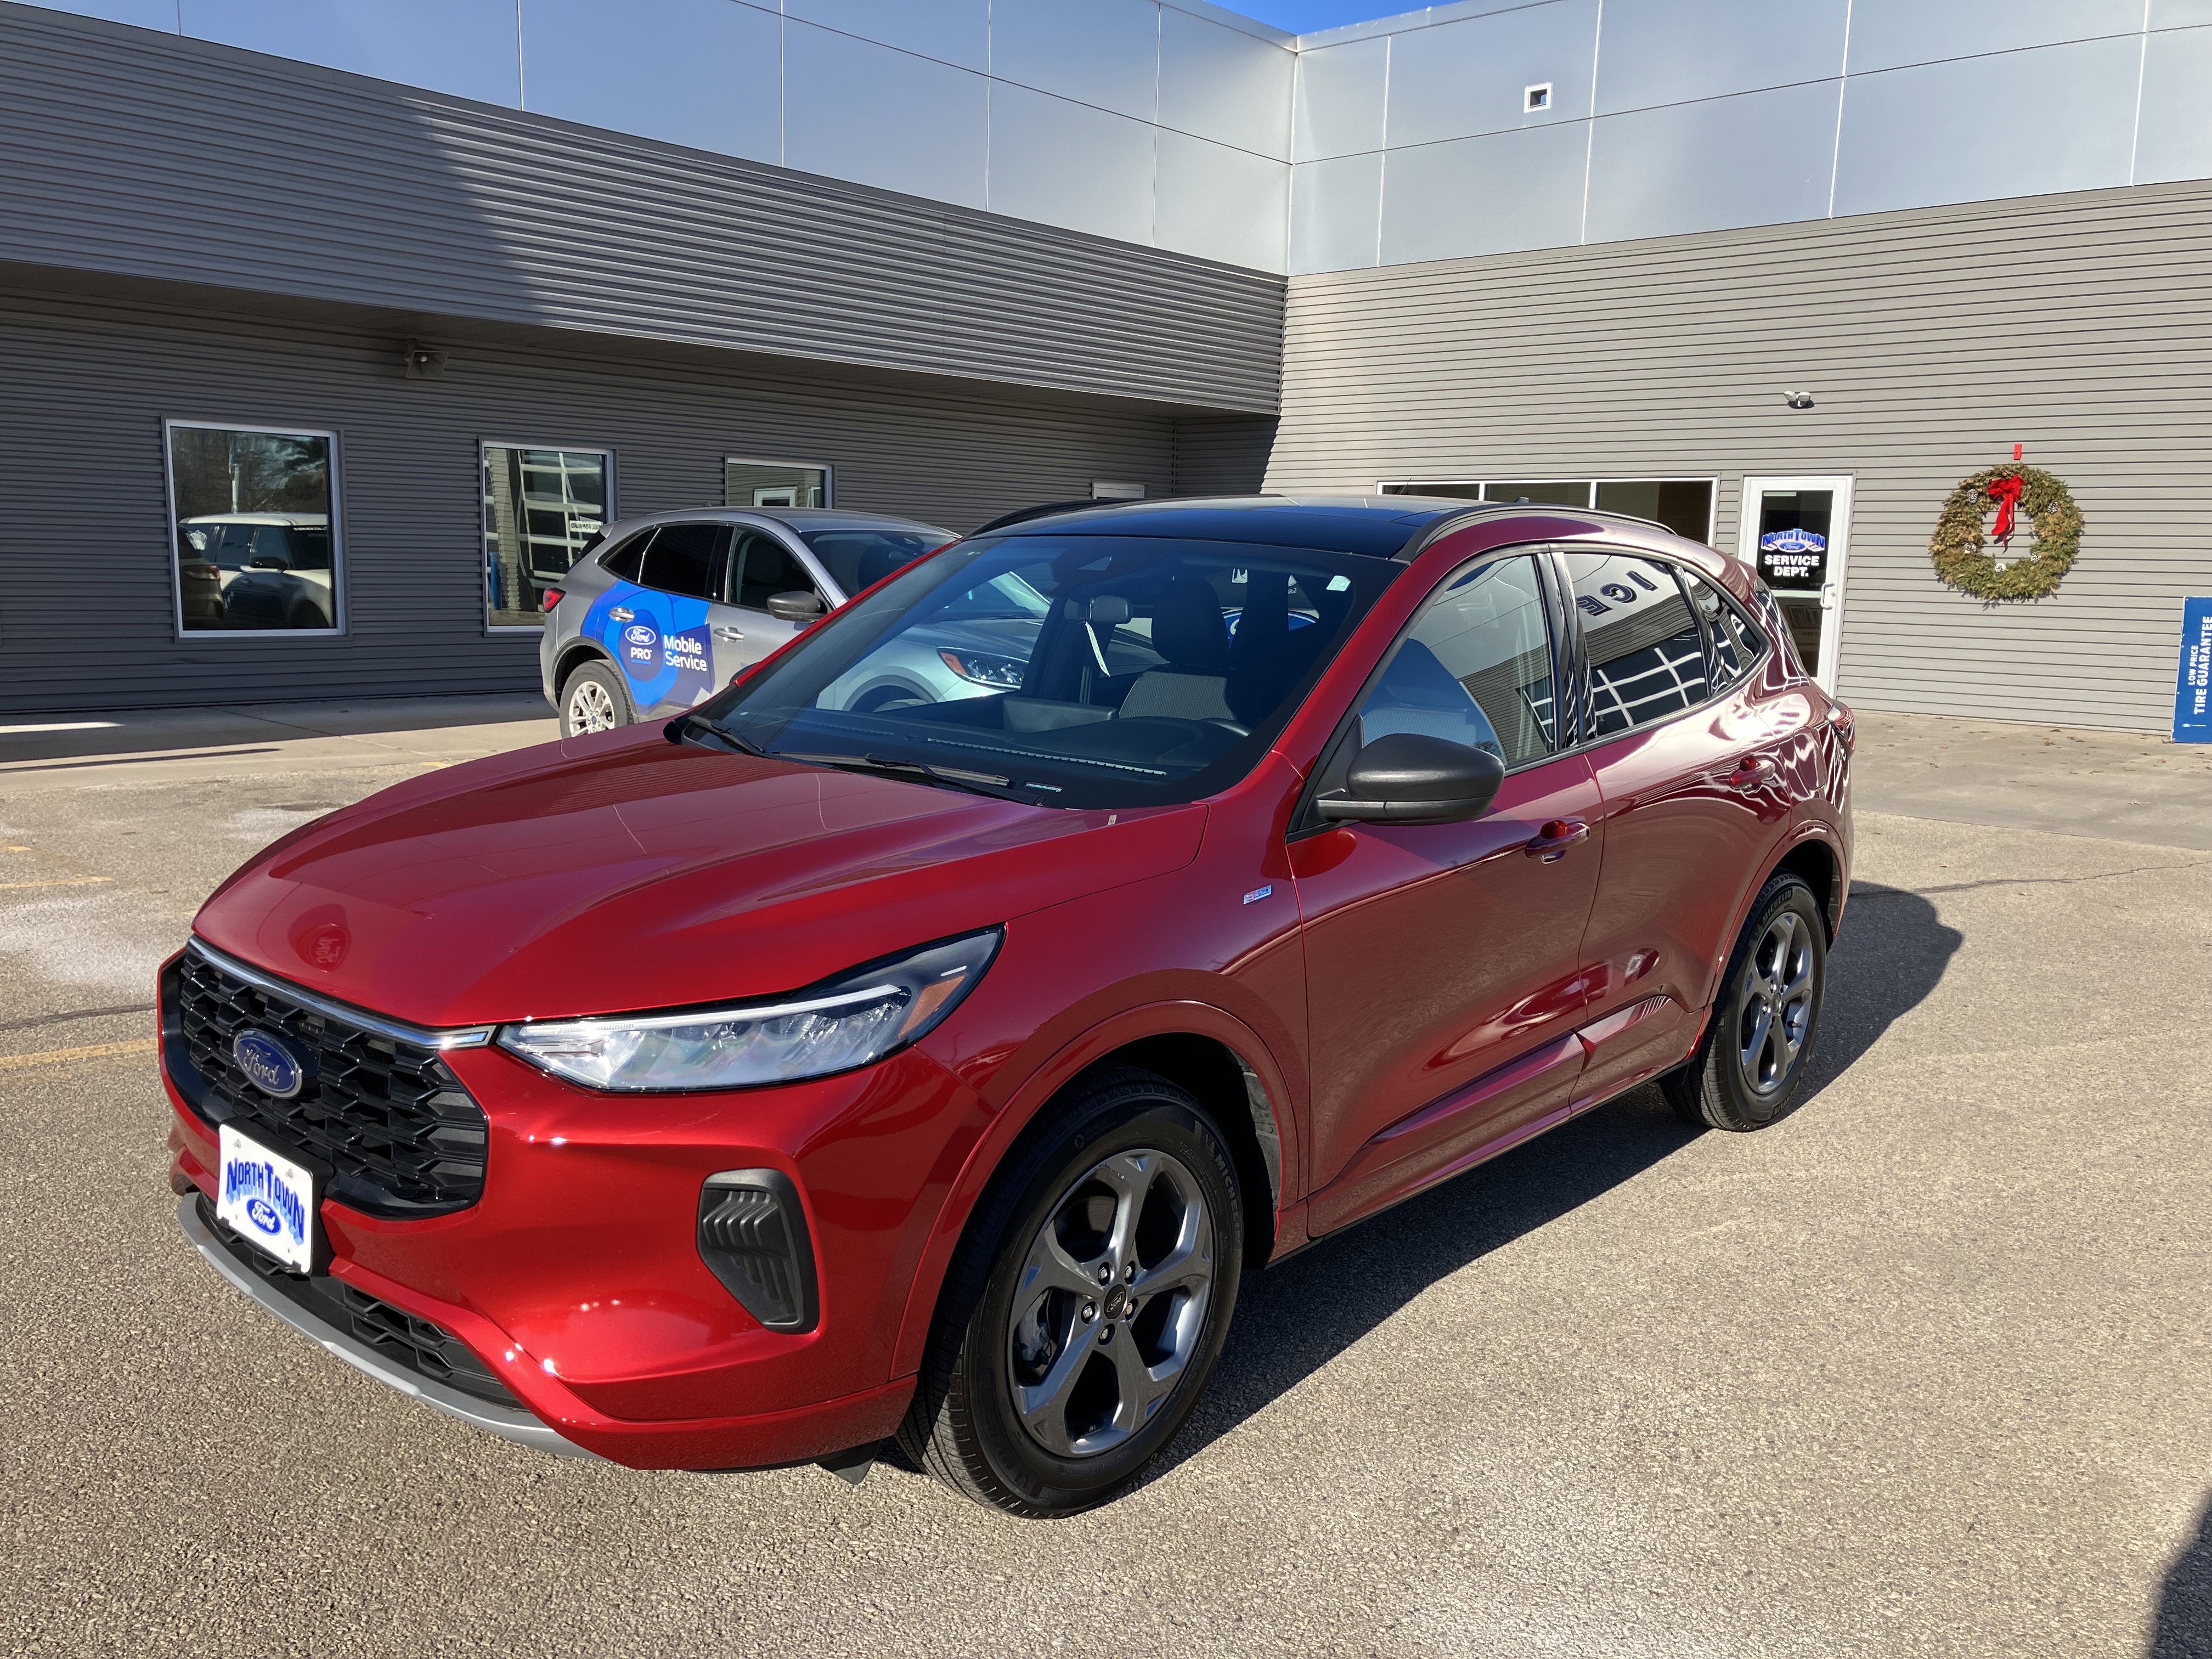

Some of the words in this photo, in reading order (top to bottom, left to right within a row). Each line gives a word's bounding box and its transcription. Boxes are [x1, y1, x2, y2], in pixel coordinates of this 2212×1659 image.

[1764, 555, 1820, 566] SERVICE
[1774, 566, 1809, 577] DEPT.
[631, 627, 651, 643] Ford
[663, 634, 702, 655] Mobile
[665, 651, 708, 672] Service
[2190, 645, 2199, 667] PRICE
[2197, 616, 2212, 686] GUARANTEE
[2194, 688, 2207, 715] TIRE
[243, 1043, 280, 1085] Ford
[251, 1201, 276, 1232] Ford
[1110, 1295, 1122, 1310] Ford
